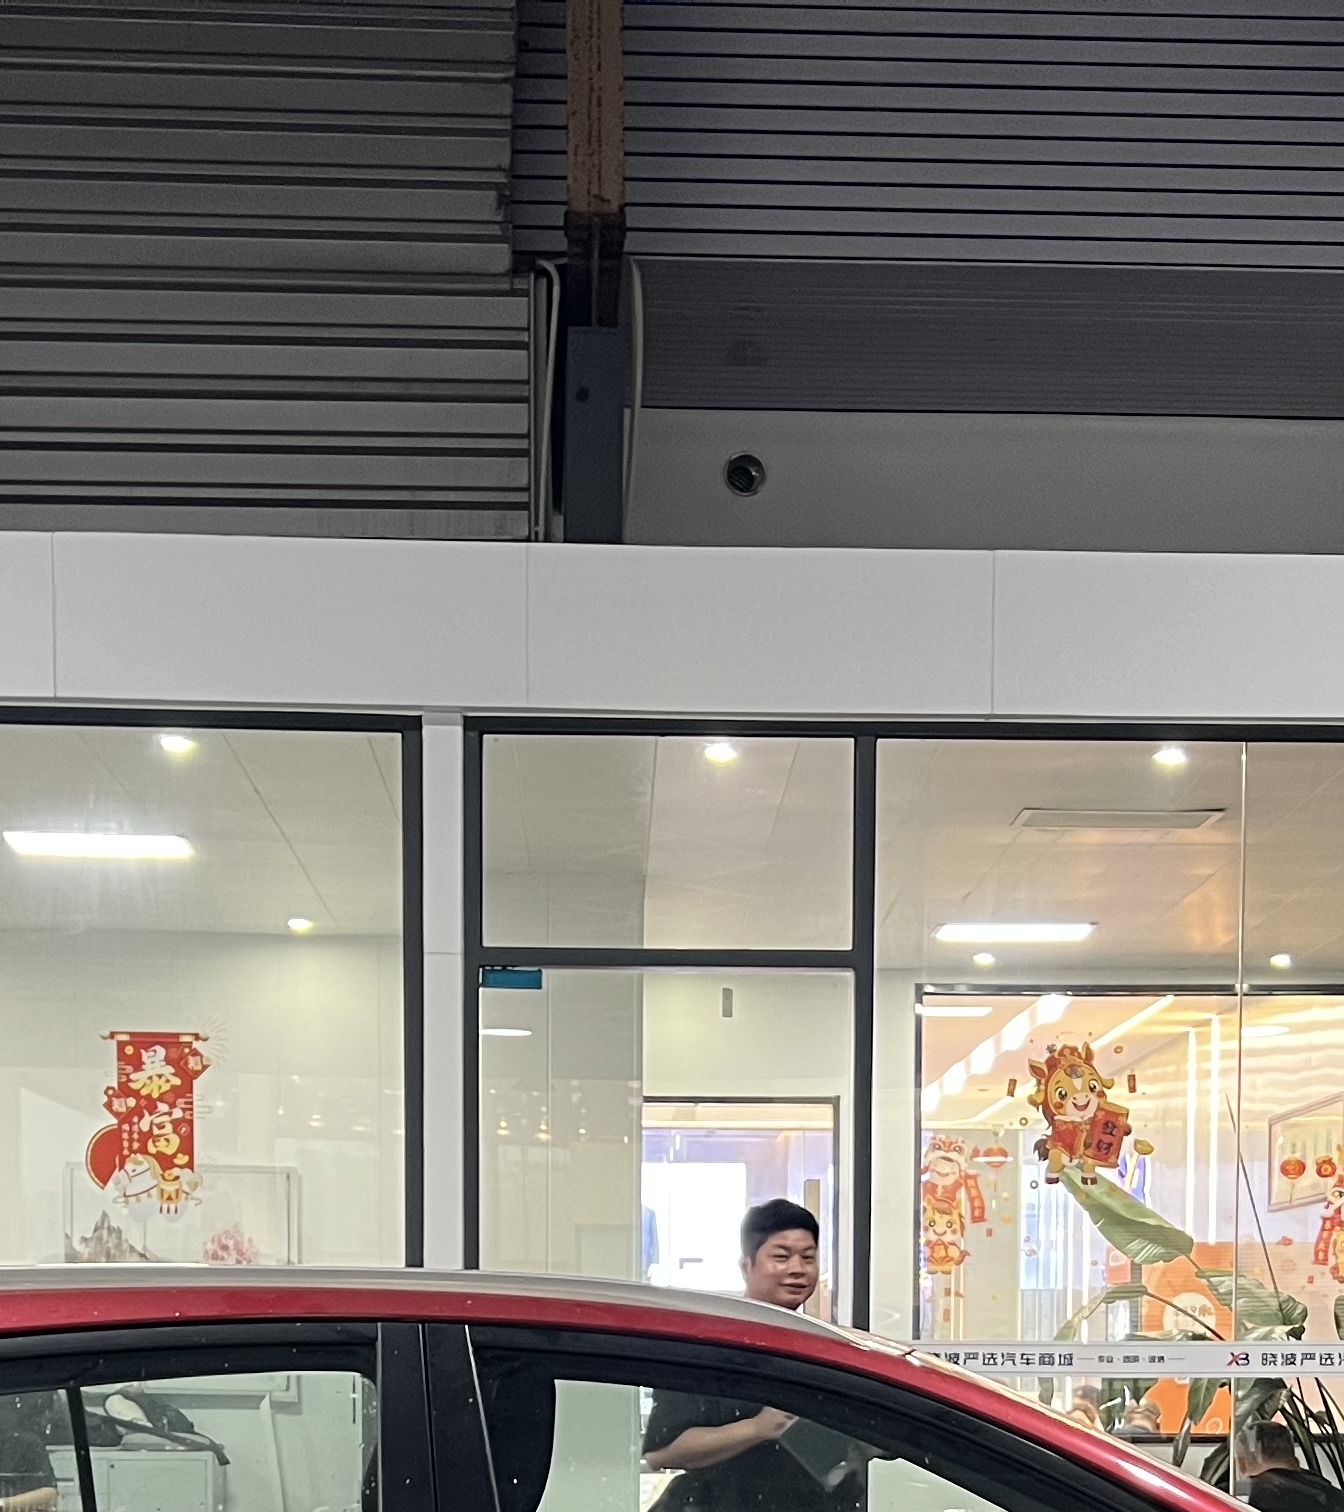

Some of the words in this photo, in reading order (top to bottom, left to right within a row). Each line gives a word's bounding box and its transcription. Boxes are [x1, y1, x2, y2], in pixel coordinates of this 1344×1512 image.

[127, 1045, 182, 1155] 暴富
[927, 1351, 1074, 1367] 波严选汽车商城
